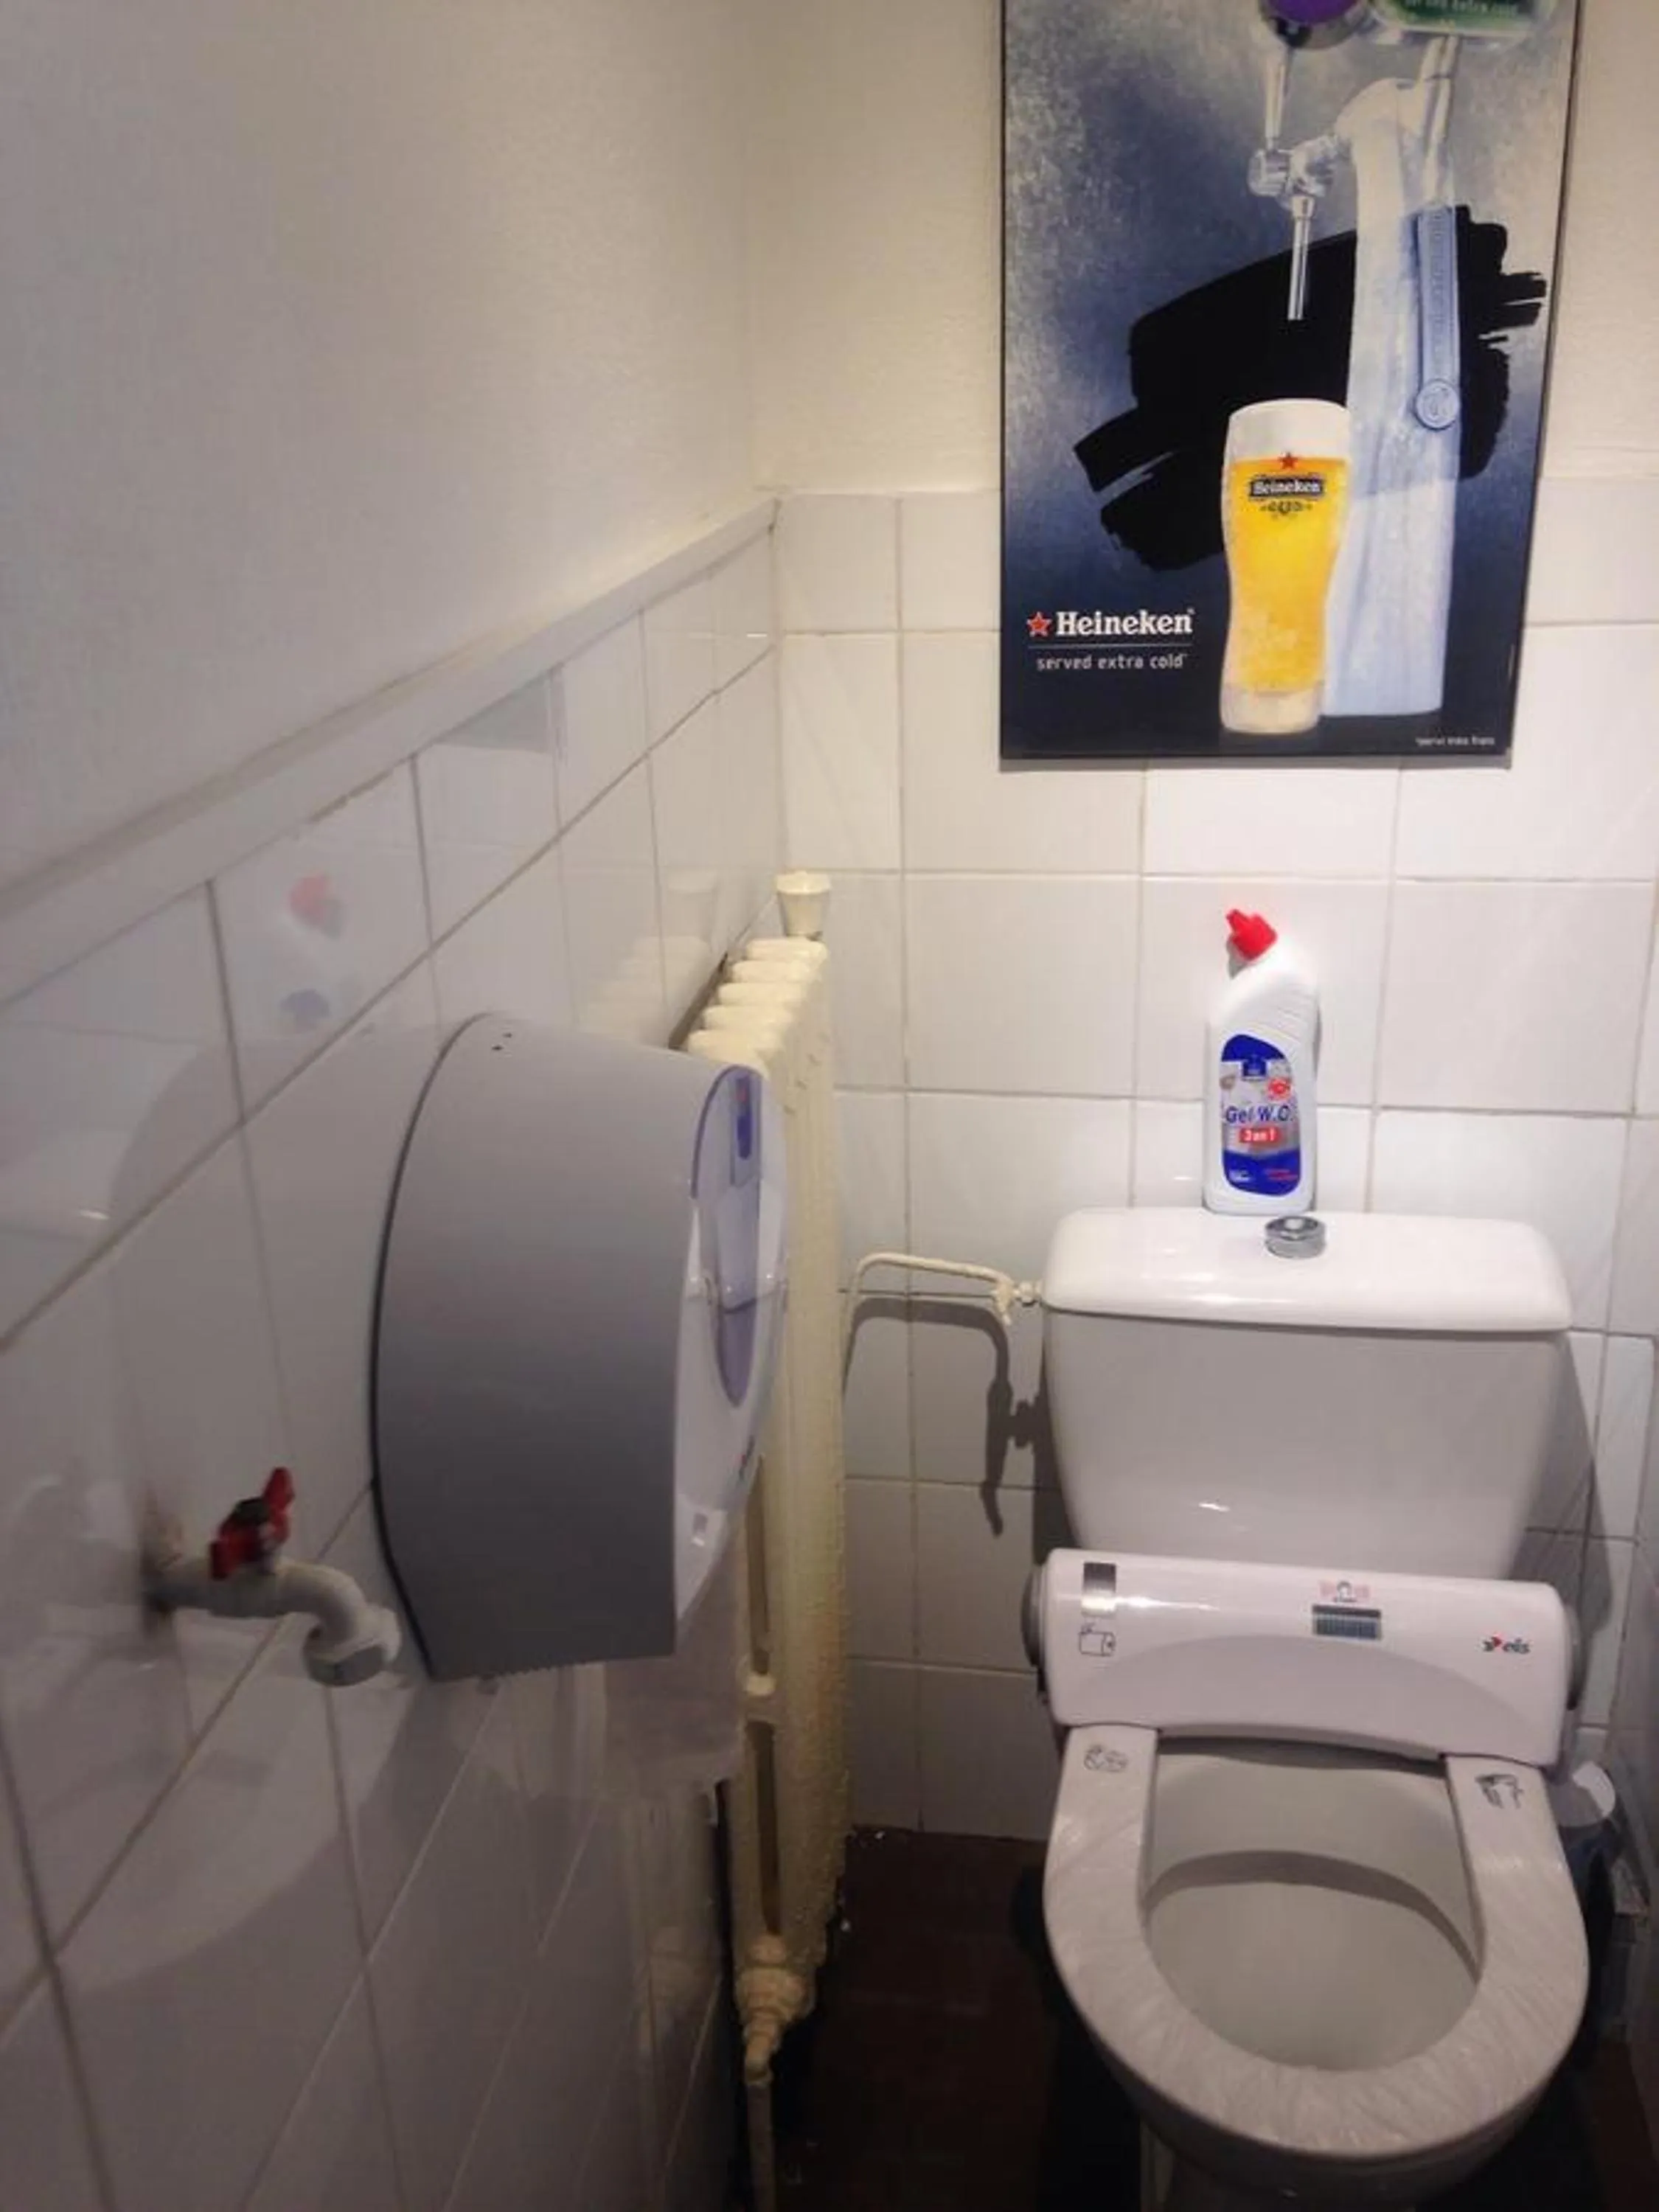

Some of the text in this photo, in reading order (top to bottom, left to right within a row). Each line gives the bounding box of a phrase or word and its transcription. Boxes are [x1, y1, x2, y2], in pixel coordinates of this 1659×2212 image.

[1055, 608, 1194, 637] Heineken
[1036, 653, 1184, 671] served extra cold
[1225, 1105, 1253, 1123] Gel
